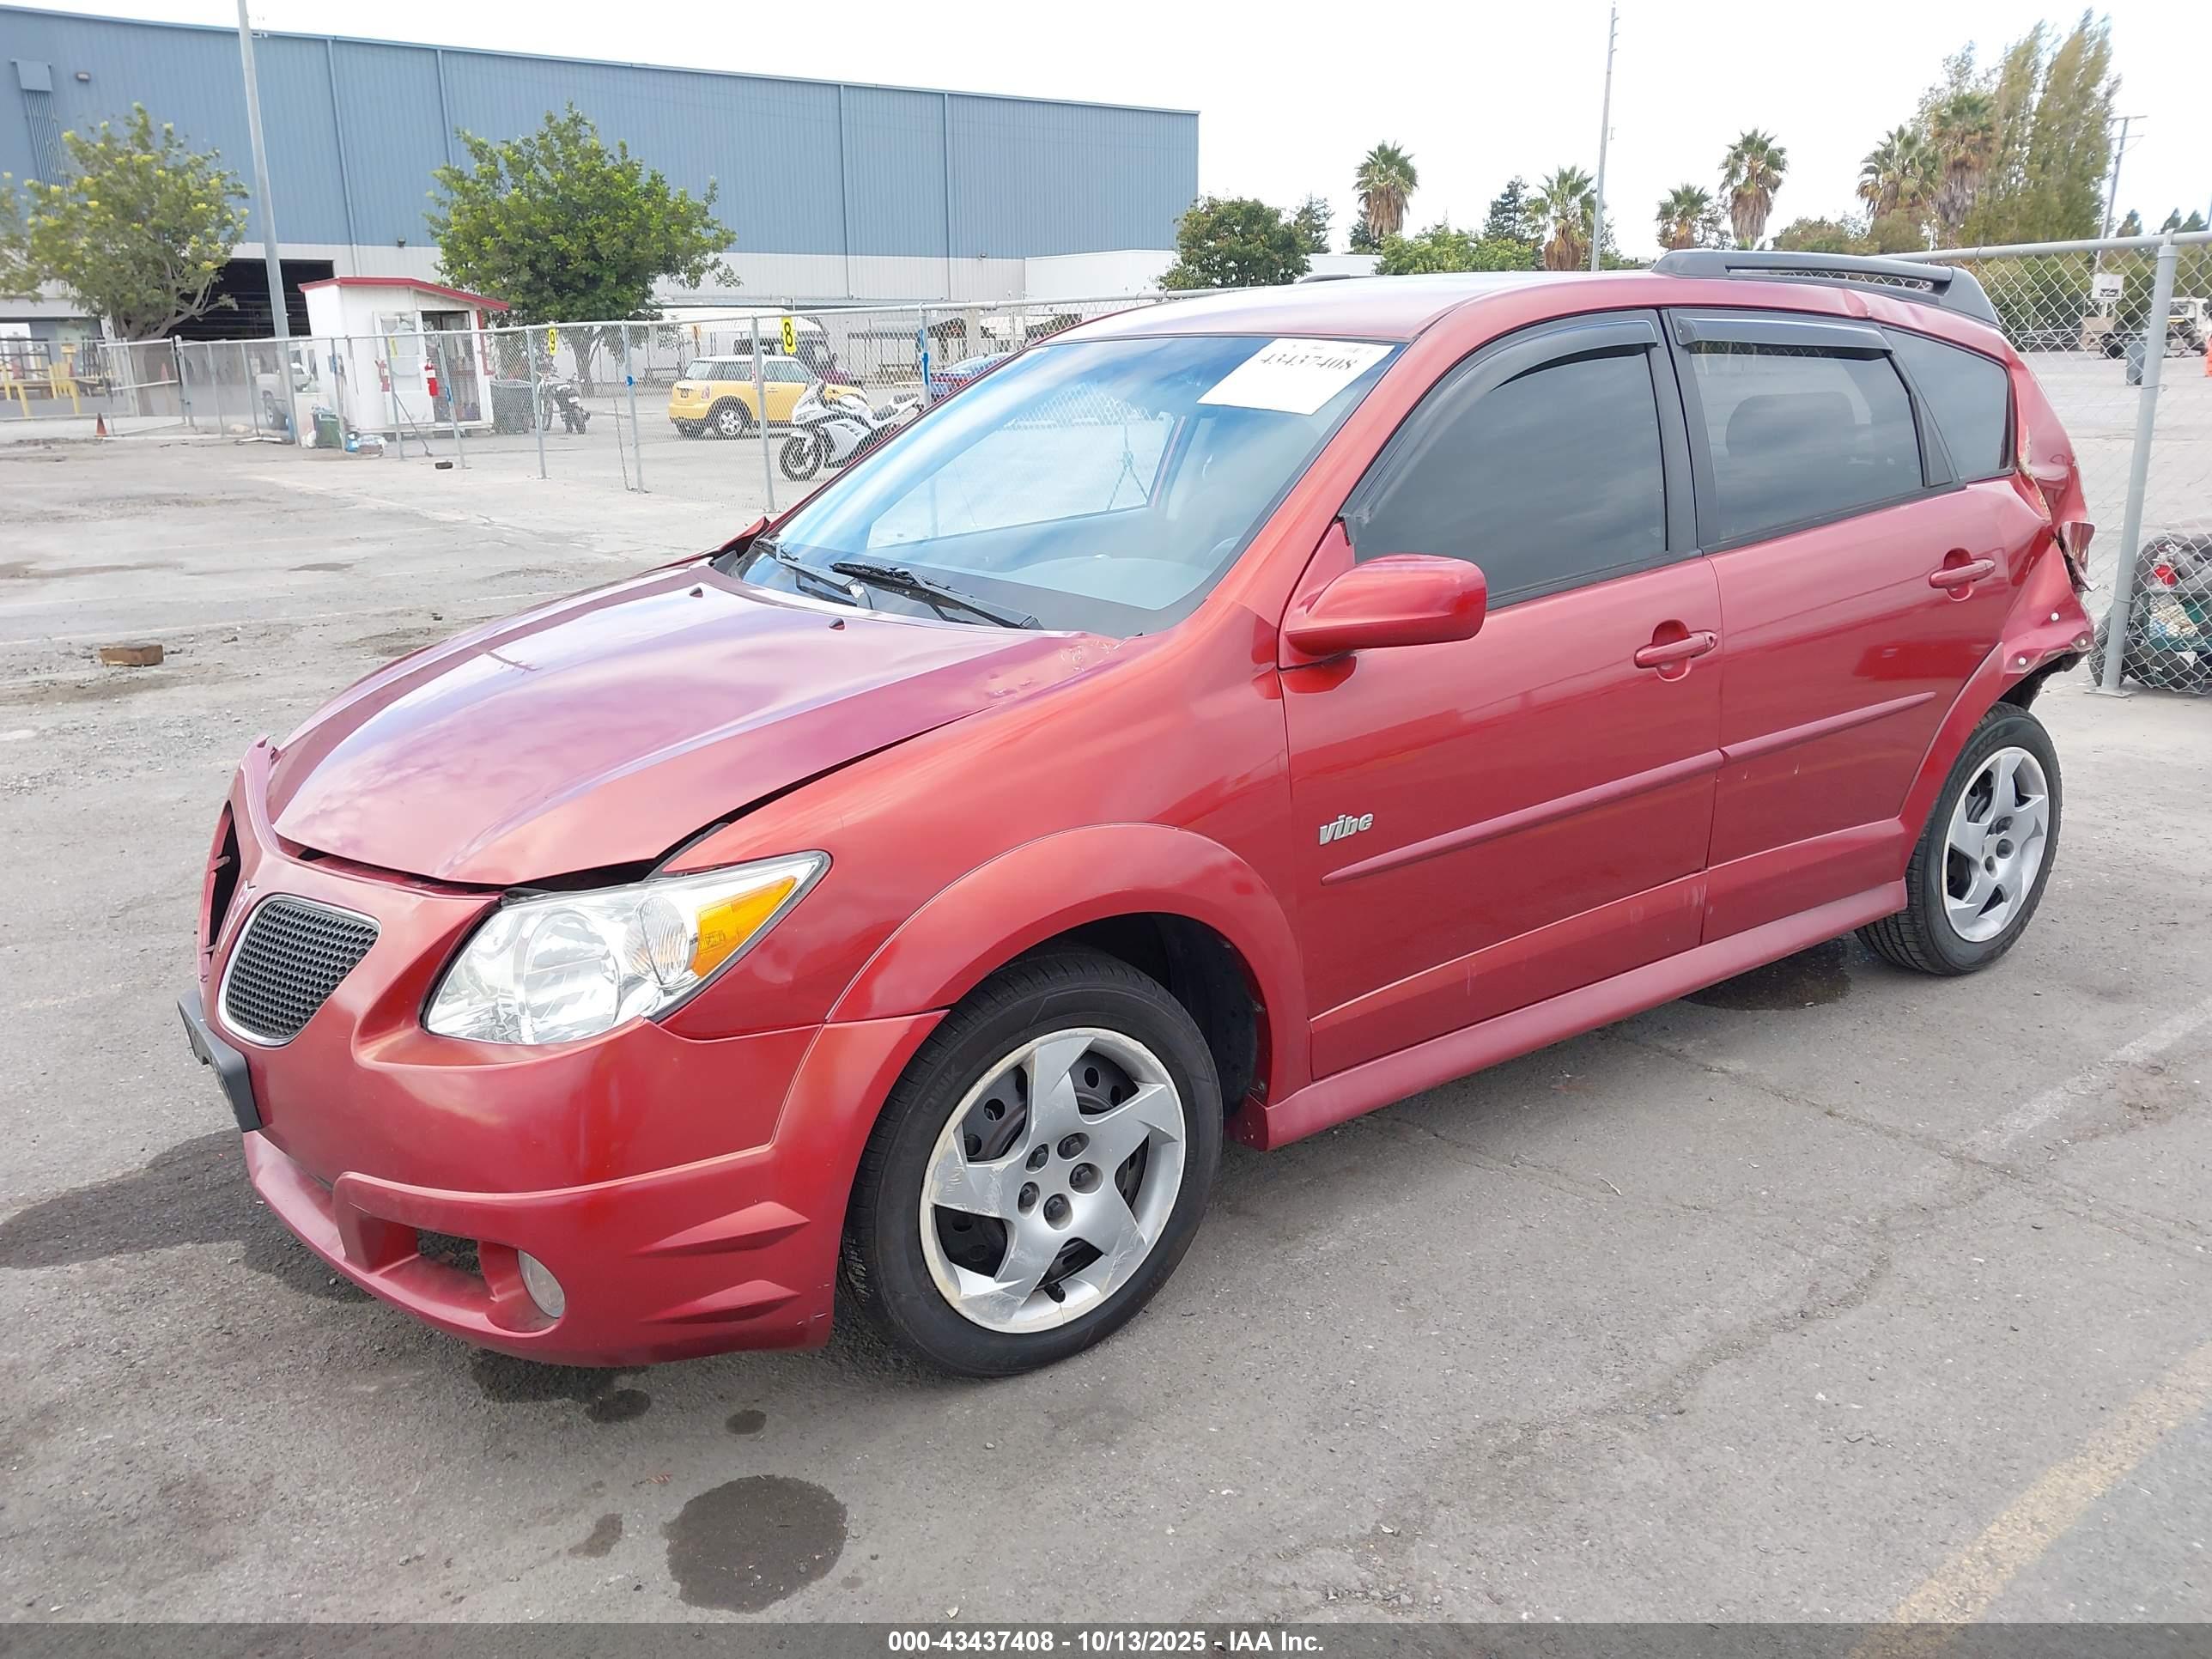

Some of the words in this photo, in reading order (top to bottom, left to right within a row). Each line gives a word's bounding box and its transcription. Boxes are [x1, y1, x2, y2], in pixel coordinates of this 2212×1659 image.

[550, 331, 556, 351] 9
[784, 321, 793, 348] 8
[1260, 352, 1358, 371] 43437408
